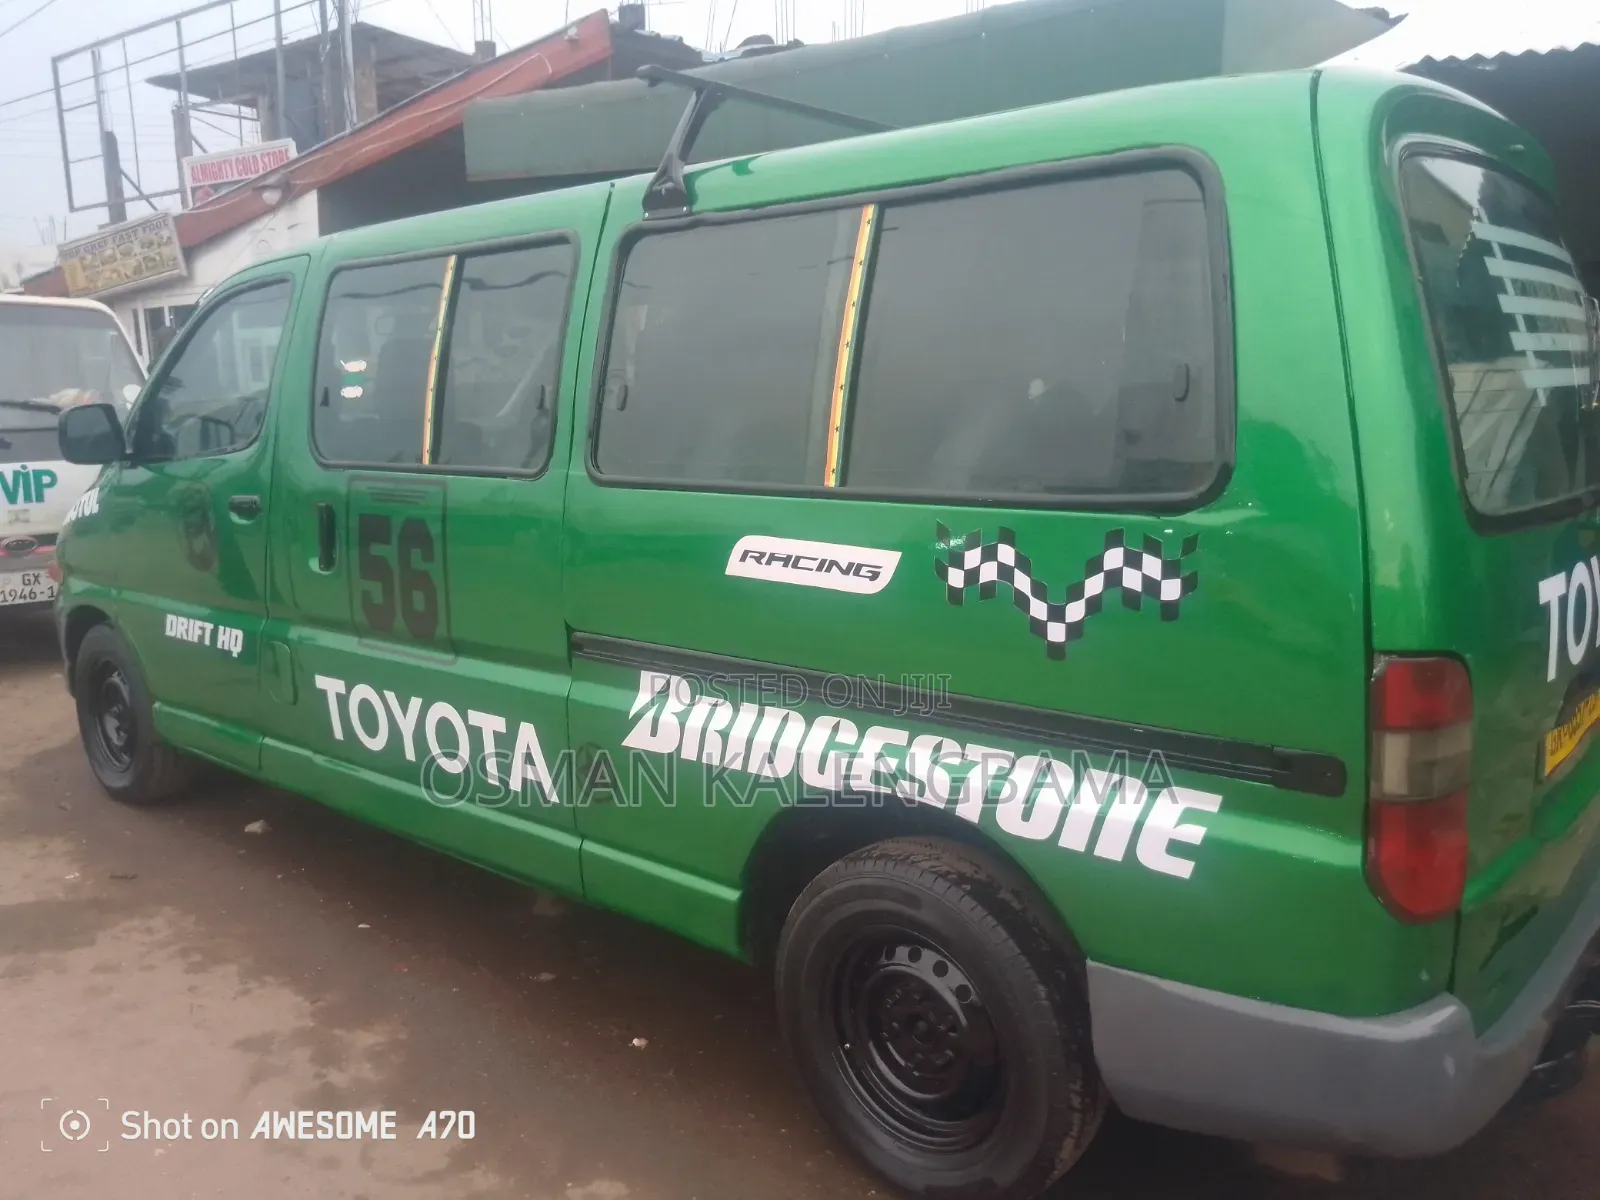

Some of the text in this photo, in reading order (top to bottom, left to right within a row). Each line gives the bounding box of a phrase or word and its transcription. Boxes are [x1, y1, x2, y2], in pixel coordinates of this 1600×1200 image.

[191, 148, 290, 184] ALMIGHTY COLD STORE
[112, 228, 138, 242] FAST
[0, 465, 58, 504] VIP
[22, 573, 41, 586] GX
[357, 513, 438, 640] 56
[738, 548, 883, 582] RACING
[165, 614, 243, 657] DRIFT HQ
[314, 674, 560, 804] TOYOTA
[621, 670, 1223, 879] BRIDGESTONE
